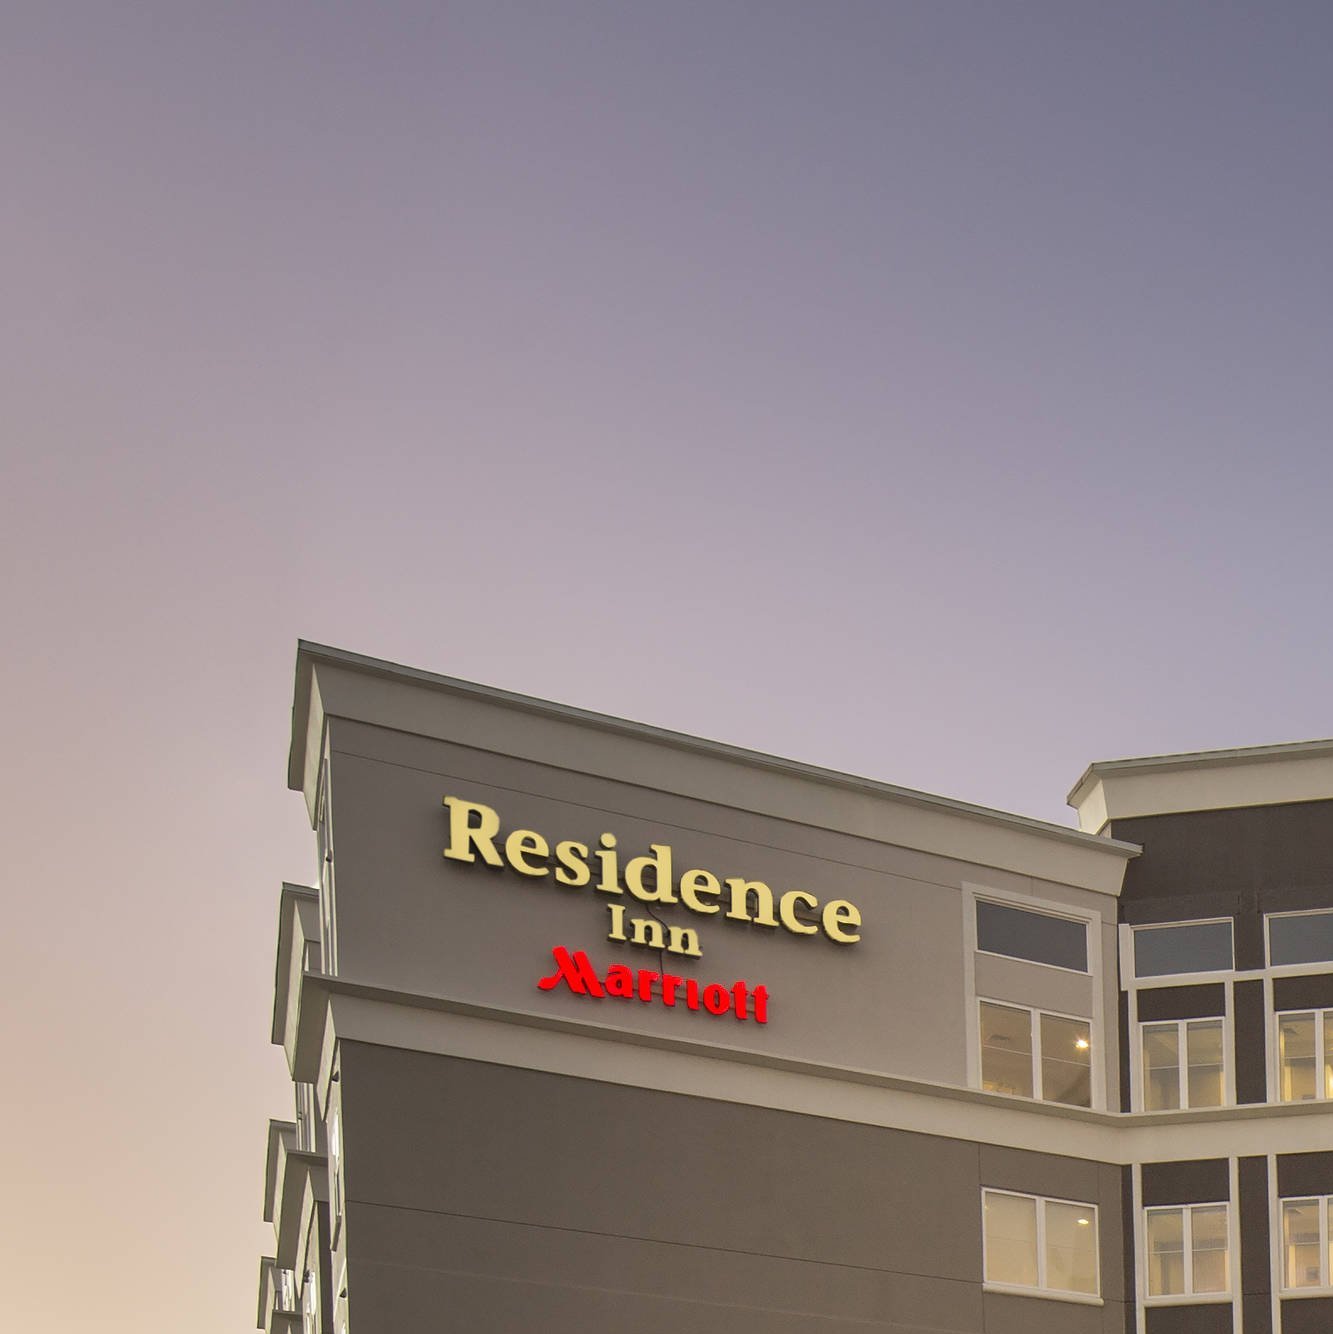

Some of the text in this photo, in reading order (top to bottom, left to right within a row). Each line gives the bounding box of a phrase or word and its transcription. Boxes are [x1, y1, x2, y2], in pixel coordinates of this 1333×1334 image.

[443, 796, 862, 944] Residence
[607, 903, 703, 957] Inn
[537, 945, 769, 1024] Marriott
